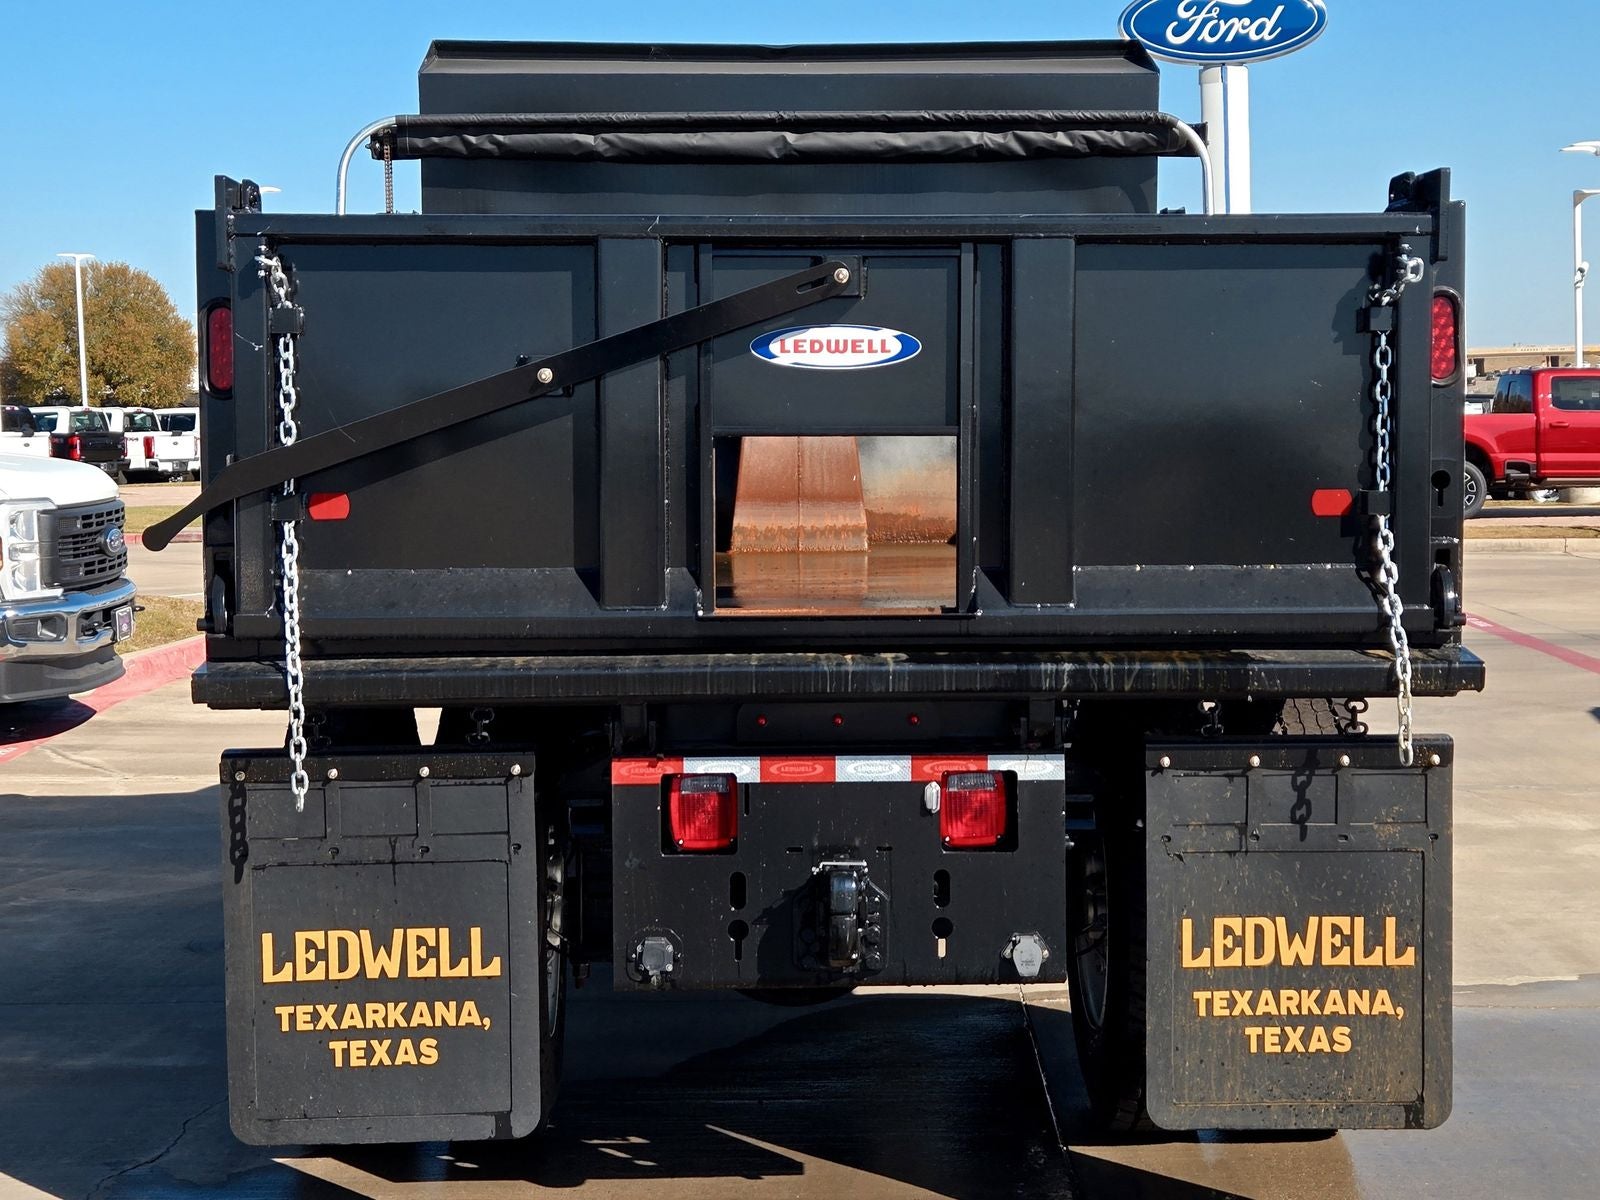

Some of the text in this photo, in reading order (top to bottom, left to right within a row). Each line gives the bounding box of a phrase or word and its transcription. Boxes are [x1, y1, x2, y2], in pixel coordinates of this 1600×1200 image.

[1165, 0, 1286, 45] Ford
[779, 338, 892, 354] LEDWELL
[261, 926, 502, 984] LEDWELL
[1181, 915, 1416, 969] LEDWELL
[274, 1000, 492, 1032] TEXARKANA,
[1192, 988, 1405, 1020] TEXARKANA,
[328, 1037, 439, 1068] TEXAS
[1244, 1026, 1352, 1054] TEXAS
